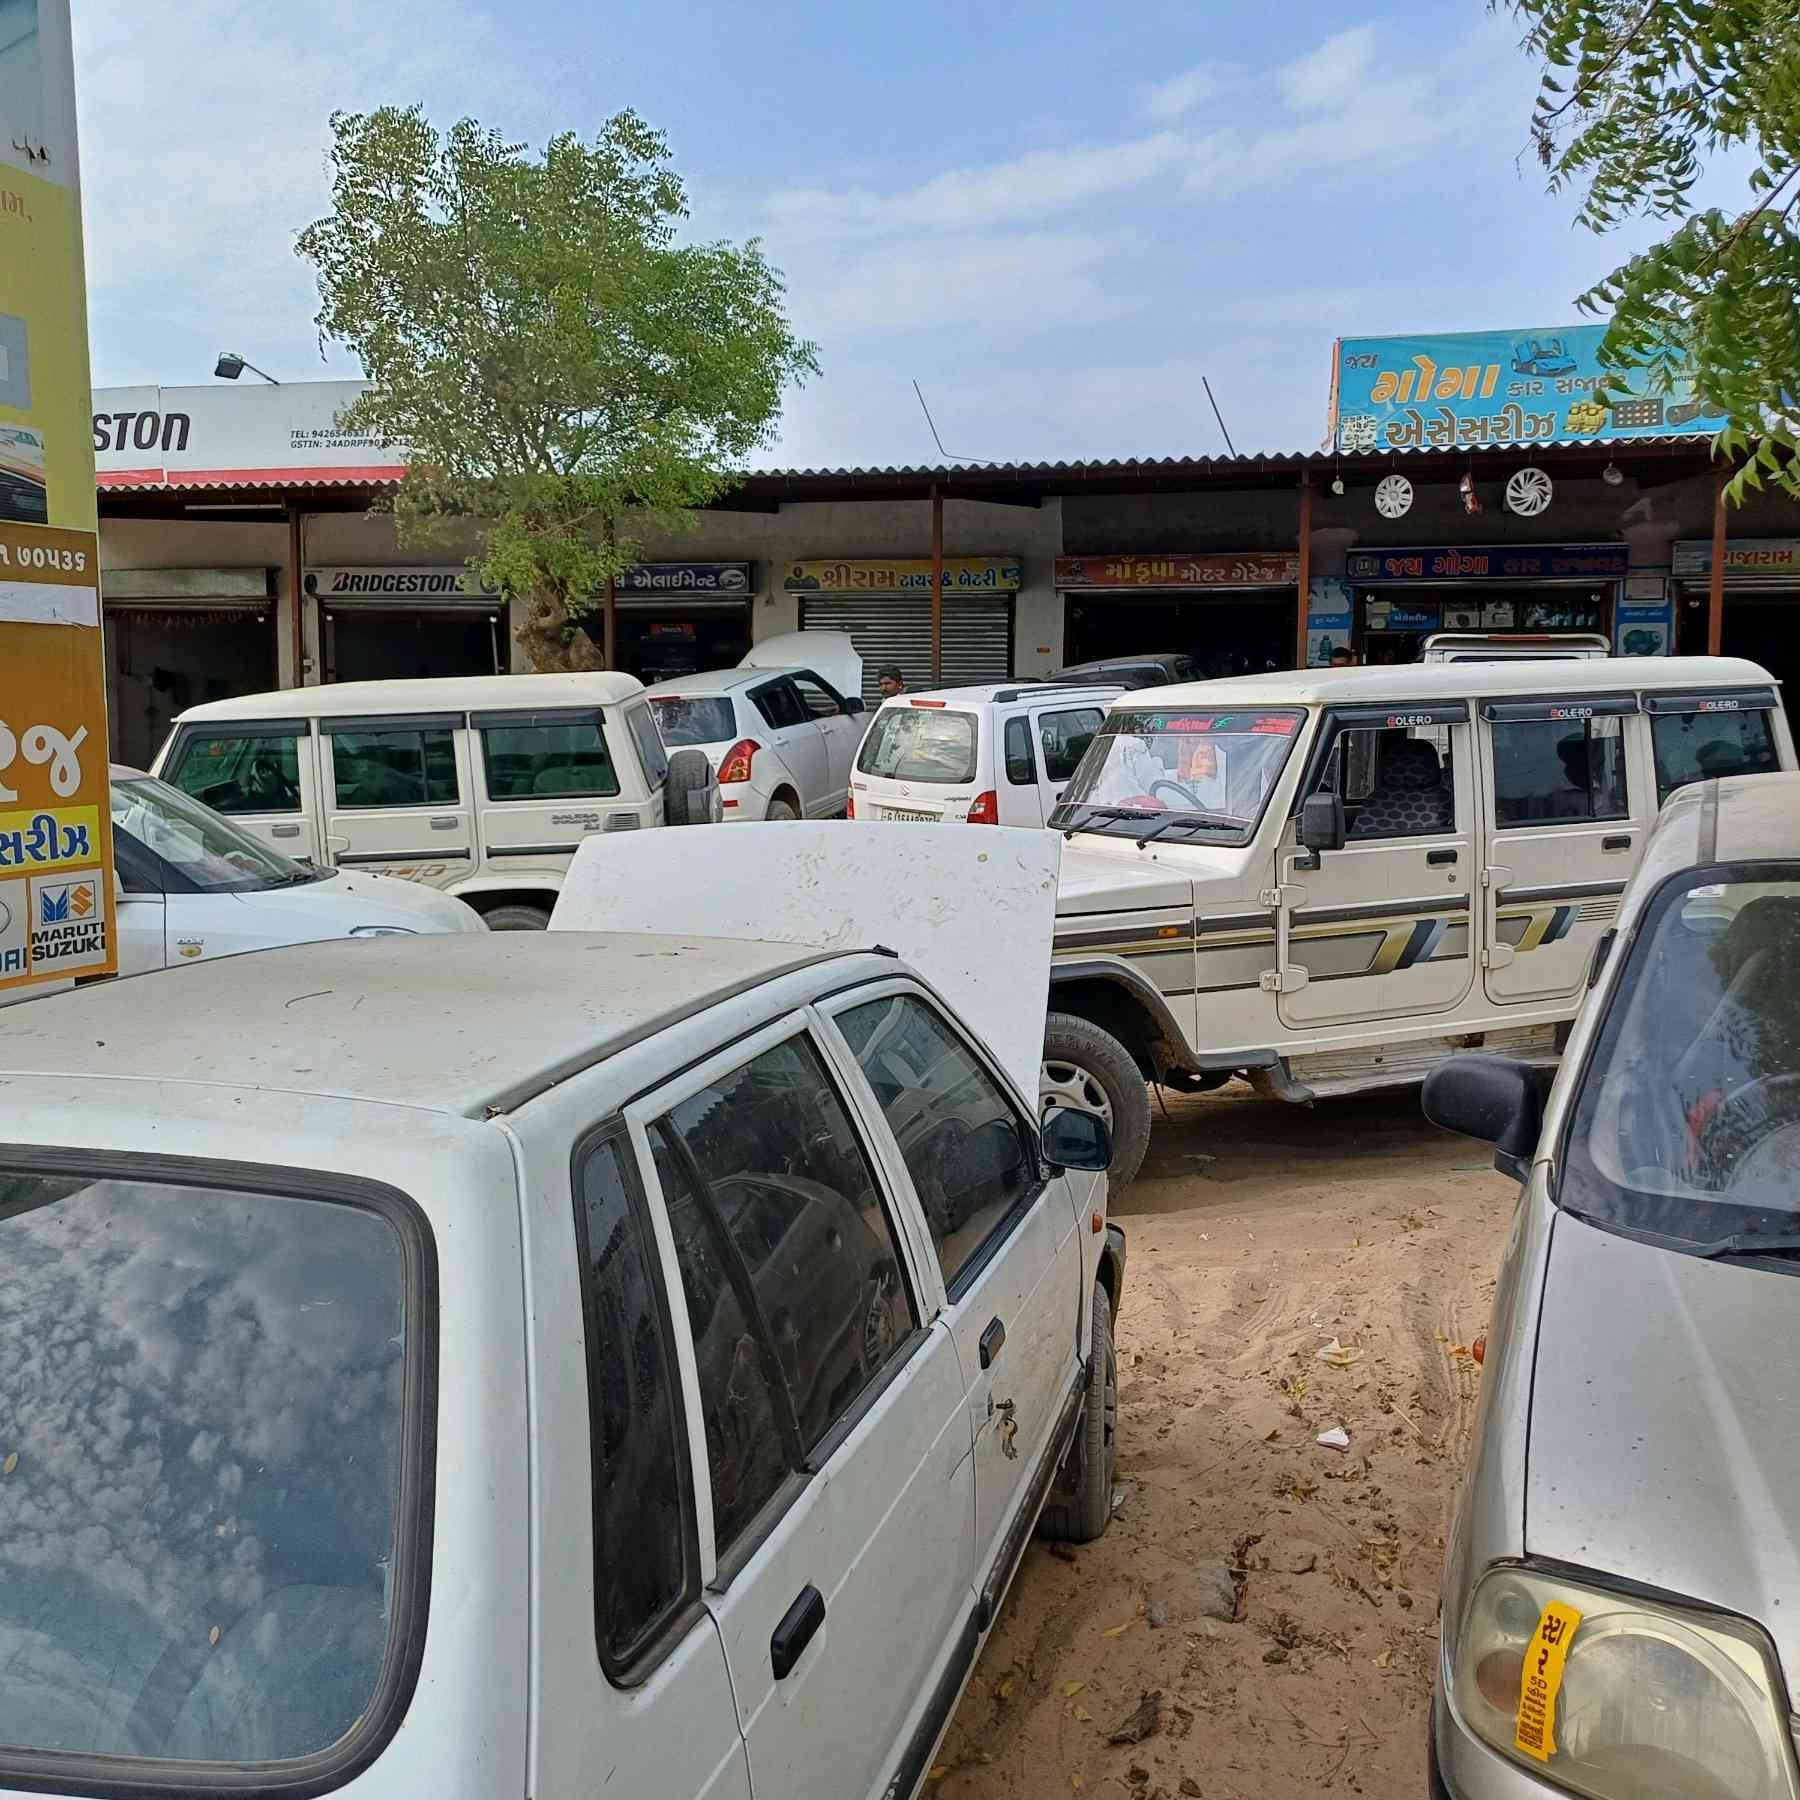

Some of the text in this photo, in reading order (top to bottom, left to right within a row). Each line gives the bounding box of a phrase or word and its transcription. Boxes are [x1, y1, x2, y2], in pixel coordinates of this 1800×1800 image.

[1370, 354, 1501, 404] ગોગા
[1507, 380, 1545, 397] કાર
[290, 430, 309, 439] TEL:
[1385, 402, 1557, 447] એસેસરીઝ
[290, 440, 323, 449] GSTIN:
[821, 563, 895, 588] શ્રીરામ
[958, 567, 997, 587] બેટરી
[1179, 562, 1227, 582] મોટર
[1231, 561, 1276, 582] ગેરેજ
[31, 921, 105, 945] MARUTI
[31, 935, 106, 961] SUZUKI
